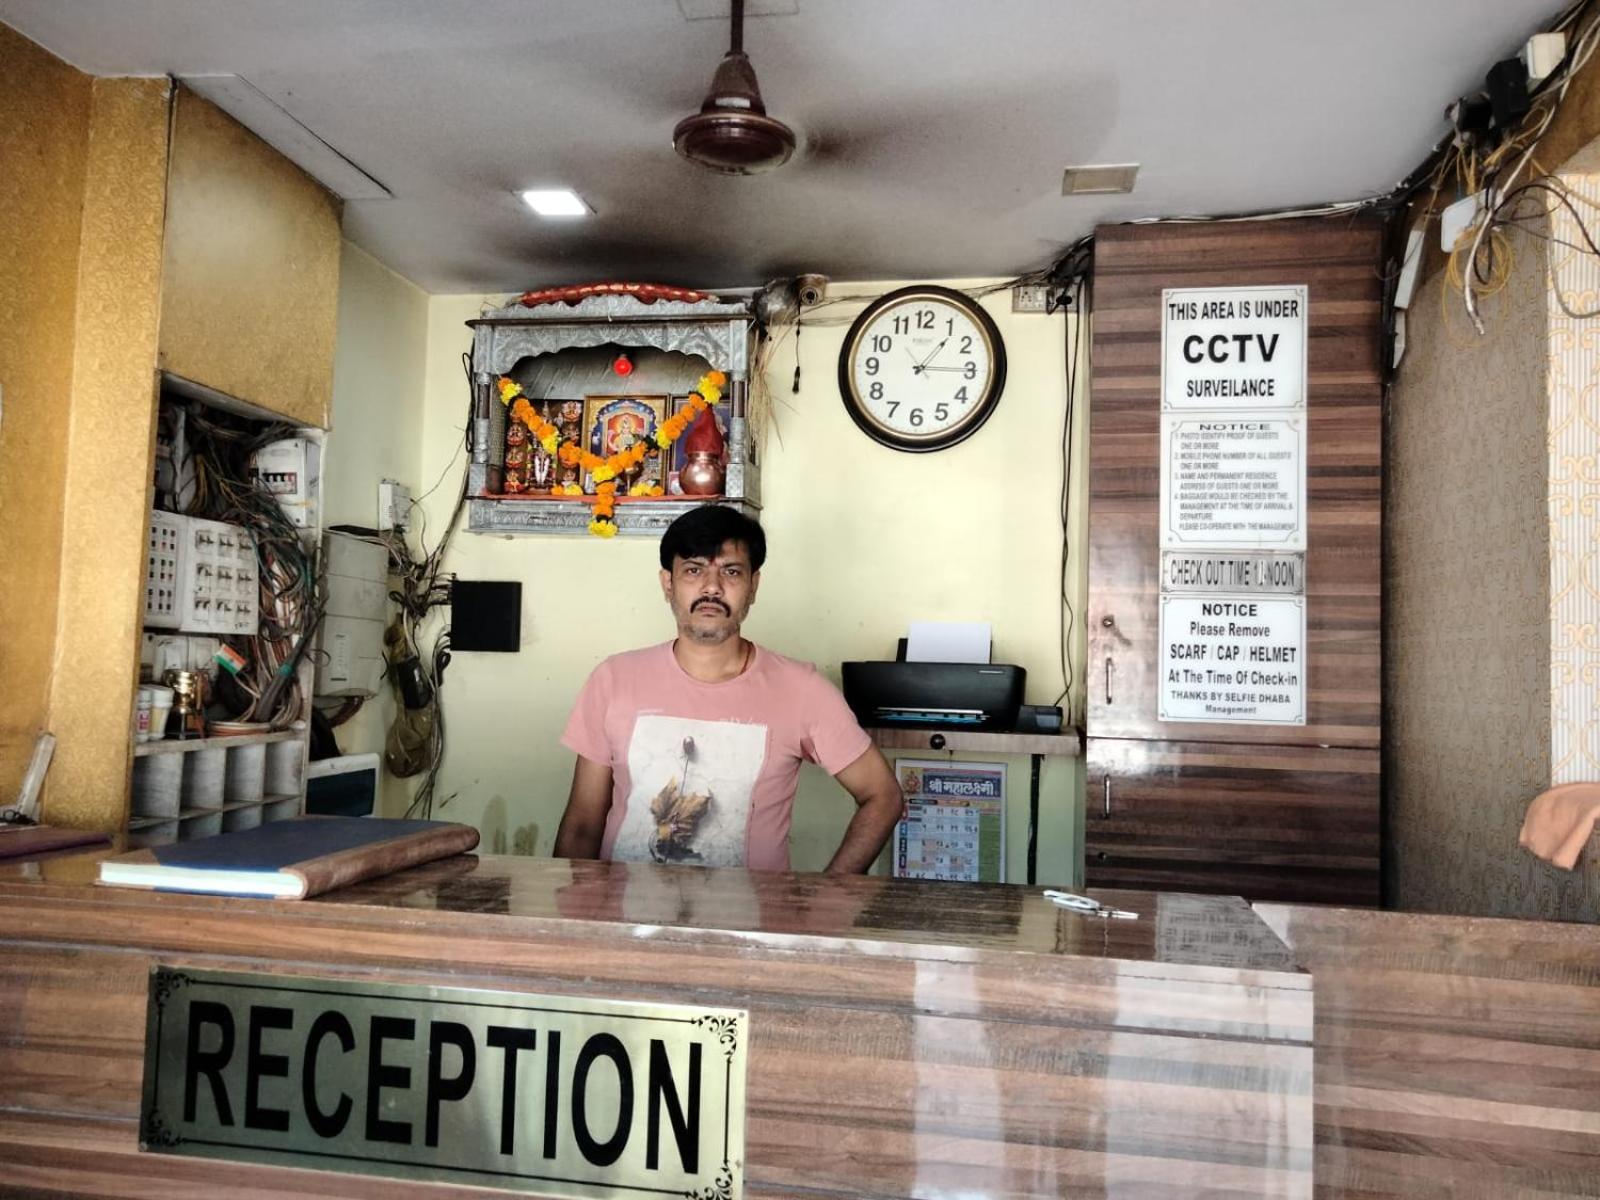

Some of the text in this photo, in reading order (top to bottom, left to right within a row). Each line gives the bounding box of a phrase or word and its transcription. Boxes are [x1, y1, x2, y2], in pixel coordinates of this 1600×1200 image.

[1169, 300, 1298, 320] THIS AREA IS UNDER
[893, 316, 909, 335] 11
[915, 310, 935, 329] 12
[946, 318, 953, 336] 1
[872, 335, 892, 353] 10
[960, 336, 972, 354] 2
[1183, 333, 1280, 363] CCTV
[865, 357, 879, 375] 9
[964, 361, 976, 380] 3
[869, 382, 884, 400] 8
[954, 386, 968, 404] 4
[1187, 379, 1275, 397] SURVEILANCE
[887, 401, 900, 418] 7
[909, 408, 924, 426] 6
[935, 403, 949, 421] 5
[1226, 432, 1246, 440] PROOF
[1247, 432, 1255, 440] OF
[1180, 452, 1200, 460] MOBILE
[1202, 452, 1220, 460] PHONE
[1222, 452, 1246, 460] NUMBER
[1247, 452, 1256, 460] OF
[1257, 452, 1267, 460] ALL
[1180, 472, 1196, 480] NAME
[1197, 472, 1209, 480] AND
[1210, 472, 1244, 480] PERMANENT
[1245, 472, 1278, 480] RESIDENCE
[1207, 482, 1215, 490] OF
[1239, 482, 1251, 490] ONE
[1253, 482, 1261, 490] OR
[1262, 482, 1279, 490] MORE
[1209, 492, 1229, 500] WOULD
[1230, 492, 1238, 500] BE
[1267, 492, 1275, 500] BY
[1276, 492, 1288, 500] THE
[1180, 513, 1213, 521] DEPARTURE
[1170, 559, 1202, 584] CHECK
[1206, 559, 1225, 585] OUT
[1227, 560, 1250, 586] TIME
[1202, 604, 1258, 616] NOTICE
[1190, 621, 1270, 637] Please Remove
[1170, 644, 1207, 659] SCARF
[1217, 645, 1240, 660] CAP
[1250, 646, 1297, 662] HELMET
[1169, 668, 1297, 685] At The Time Of Check-in
[1171, 690, 1291, 703] THANKS BY SELFIE DHABA
[1206, 704, 1257, 715] Management
[929, 778, 942, 793] श्री
[182, 999, 702, 1175] RECEPTION
